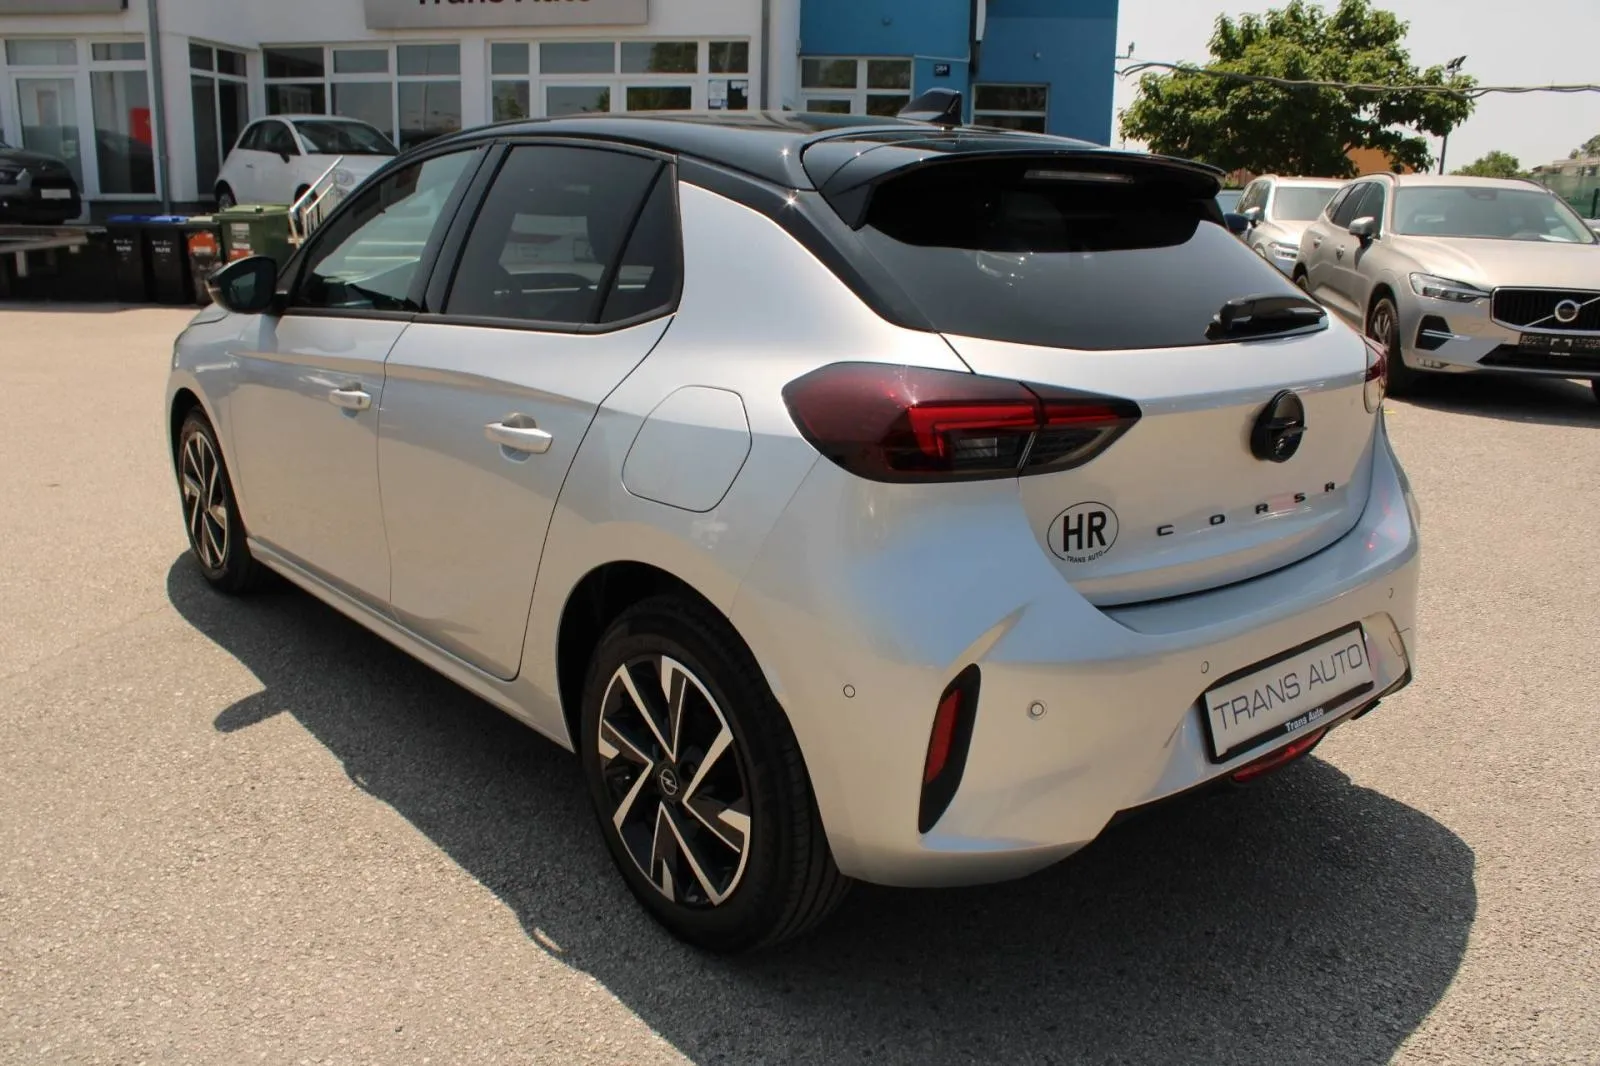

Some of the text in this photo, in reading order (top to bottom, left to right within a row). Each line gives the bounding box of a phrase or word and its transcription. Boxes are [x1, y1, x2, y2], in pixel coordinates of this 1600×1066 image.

[1063, 511, 1106, 552] HR
[1067, 551, 1103, 563] TRANS AUTO
[1213, 643, 1363, 729] TRANS AUTO
[1285, 708, 1324, 731] Trans Auto
